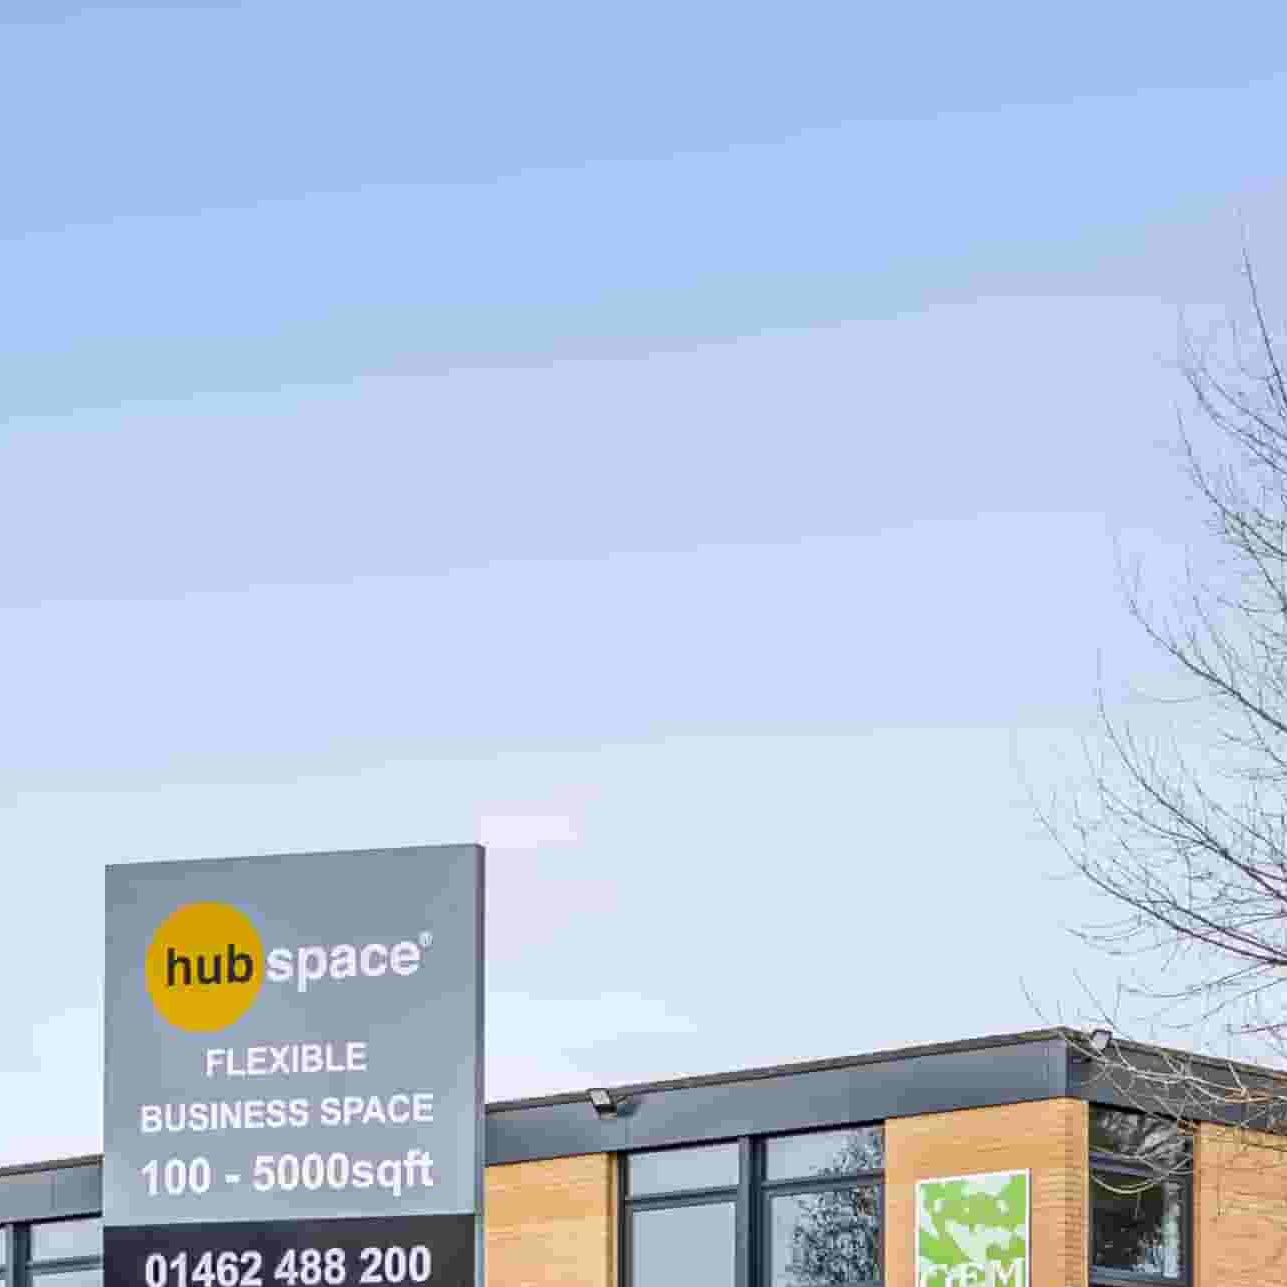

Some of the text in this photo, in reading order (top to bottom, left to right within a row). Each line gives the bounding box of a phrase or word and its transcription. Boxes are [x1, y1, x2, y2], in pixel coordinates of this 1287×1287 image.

[165, 943, 254, 986] hub
[205, 1042, 367, 1077] FLEXIBLE
[140, 1093, 434, 1134] BUSINESS SPACE
[142, 1155, 212, 1197] 100
[252, 1148, 434, 1197] 5000sqft
[274, 1247, 347, 1286] 488
[359, 1244, 433, 1284] 200
